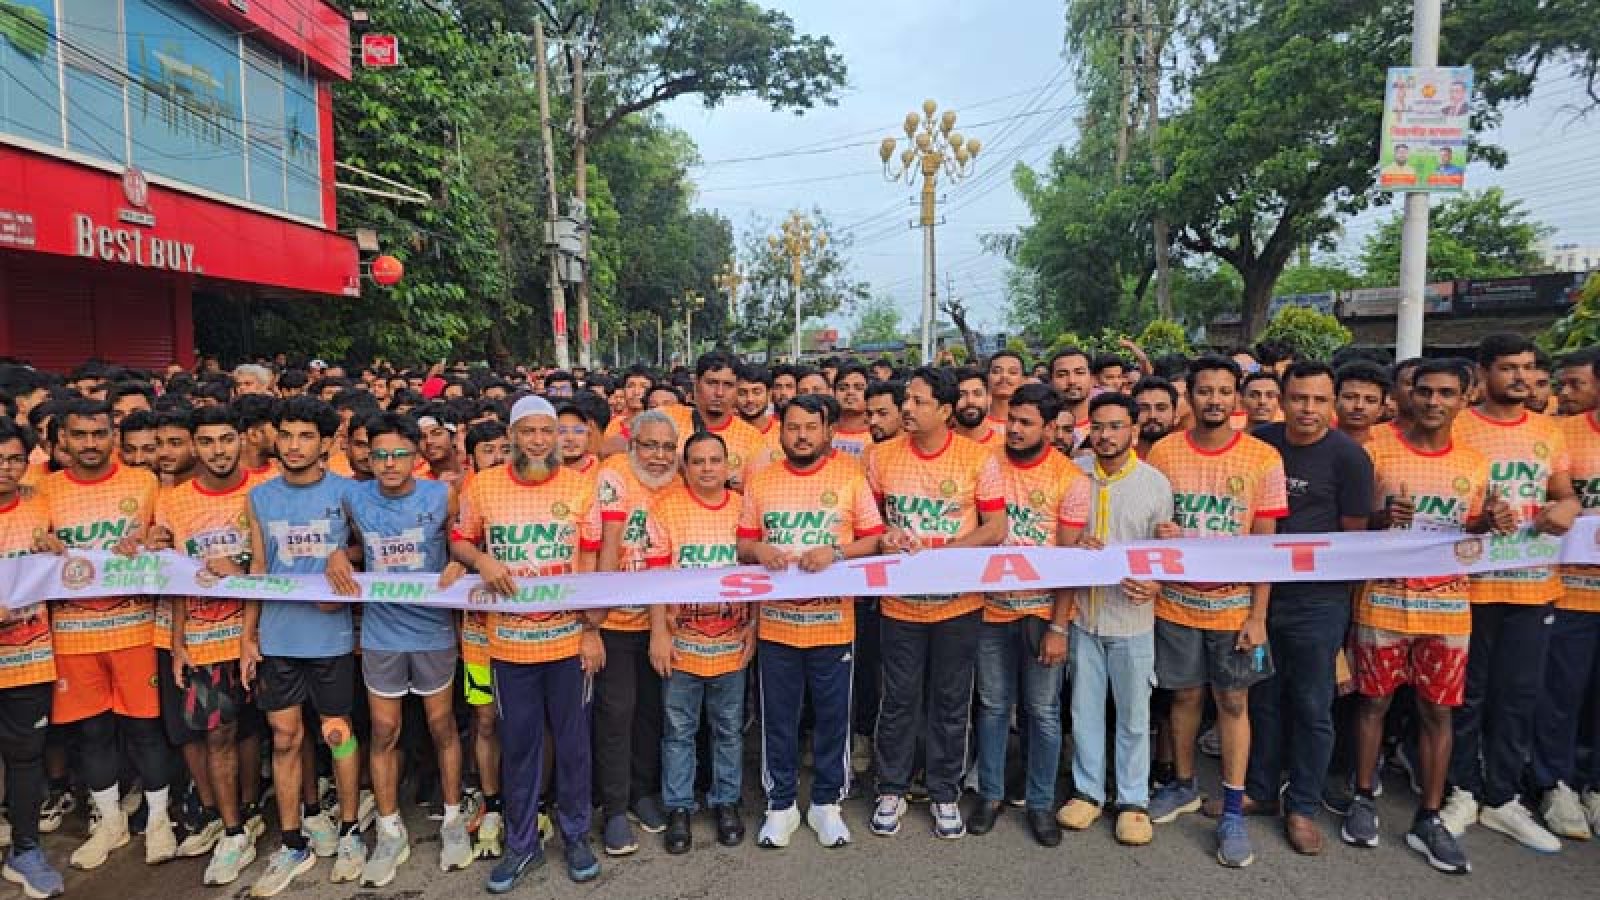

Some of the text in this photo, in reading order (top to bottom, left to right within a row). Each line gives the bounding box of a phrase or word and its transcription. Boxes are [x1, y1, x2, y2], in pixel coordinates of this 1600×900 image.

[76, 214, 145, 267] Best
[887, 495, 945, 517] RUN
[763, 511, 824, 530] RUN
[56, 518, 126, 545] RUN
[287, 533, 321, 545] 1943
[489, 523, 558, 545] RUN
[381, 542, 415, 557] 1900
[535, 542, 574, 561] City
[680, 545, 738, 563] RUN
[369, 581, 424, 599] RUN
